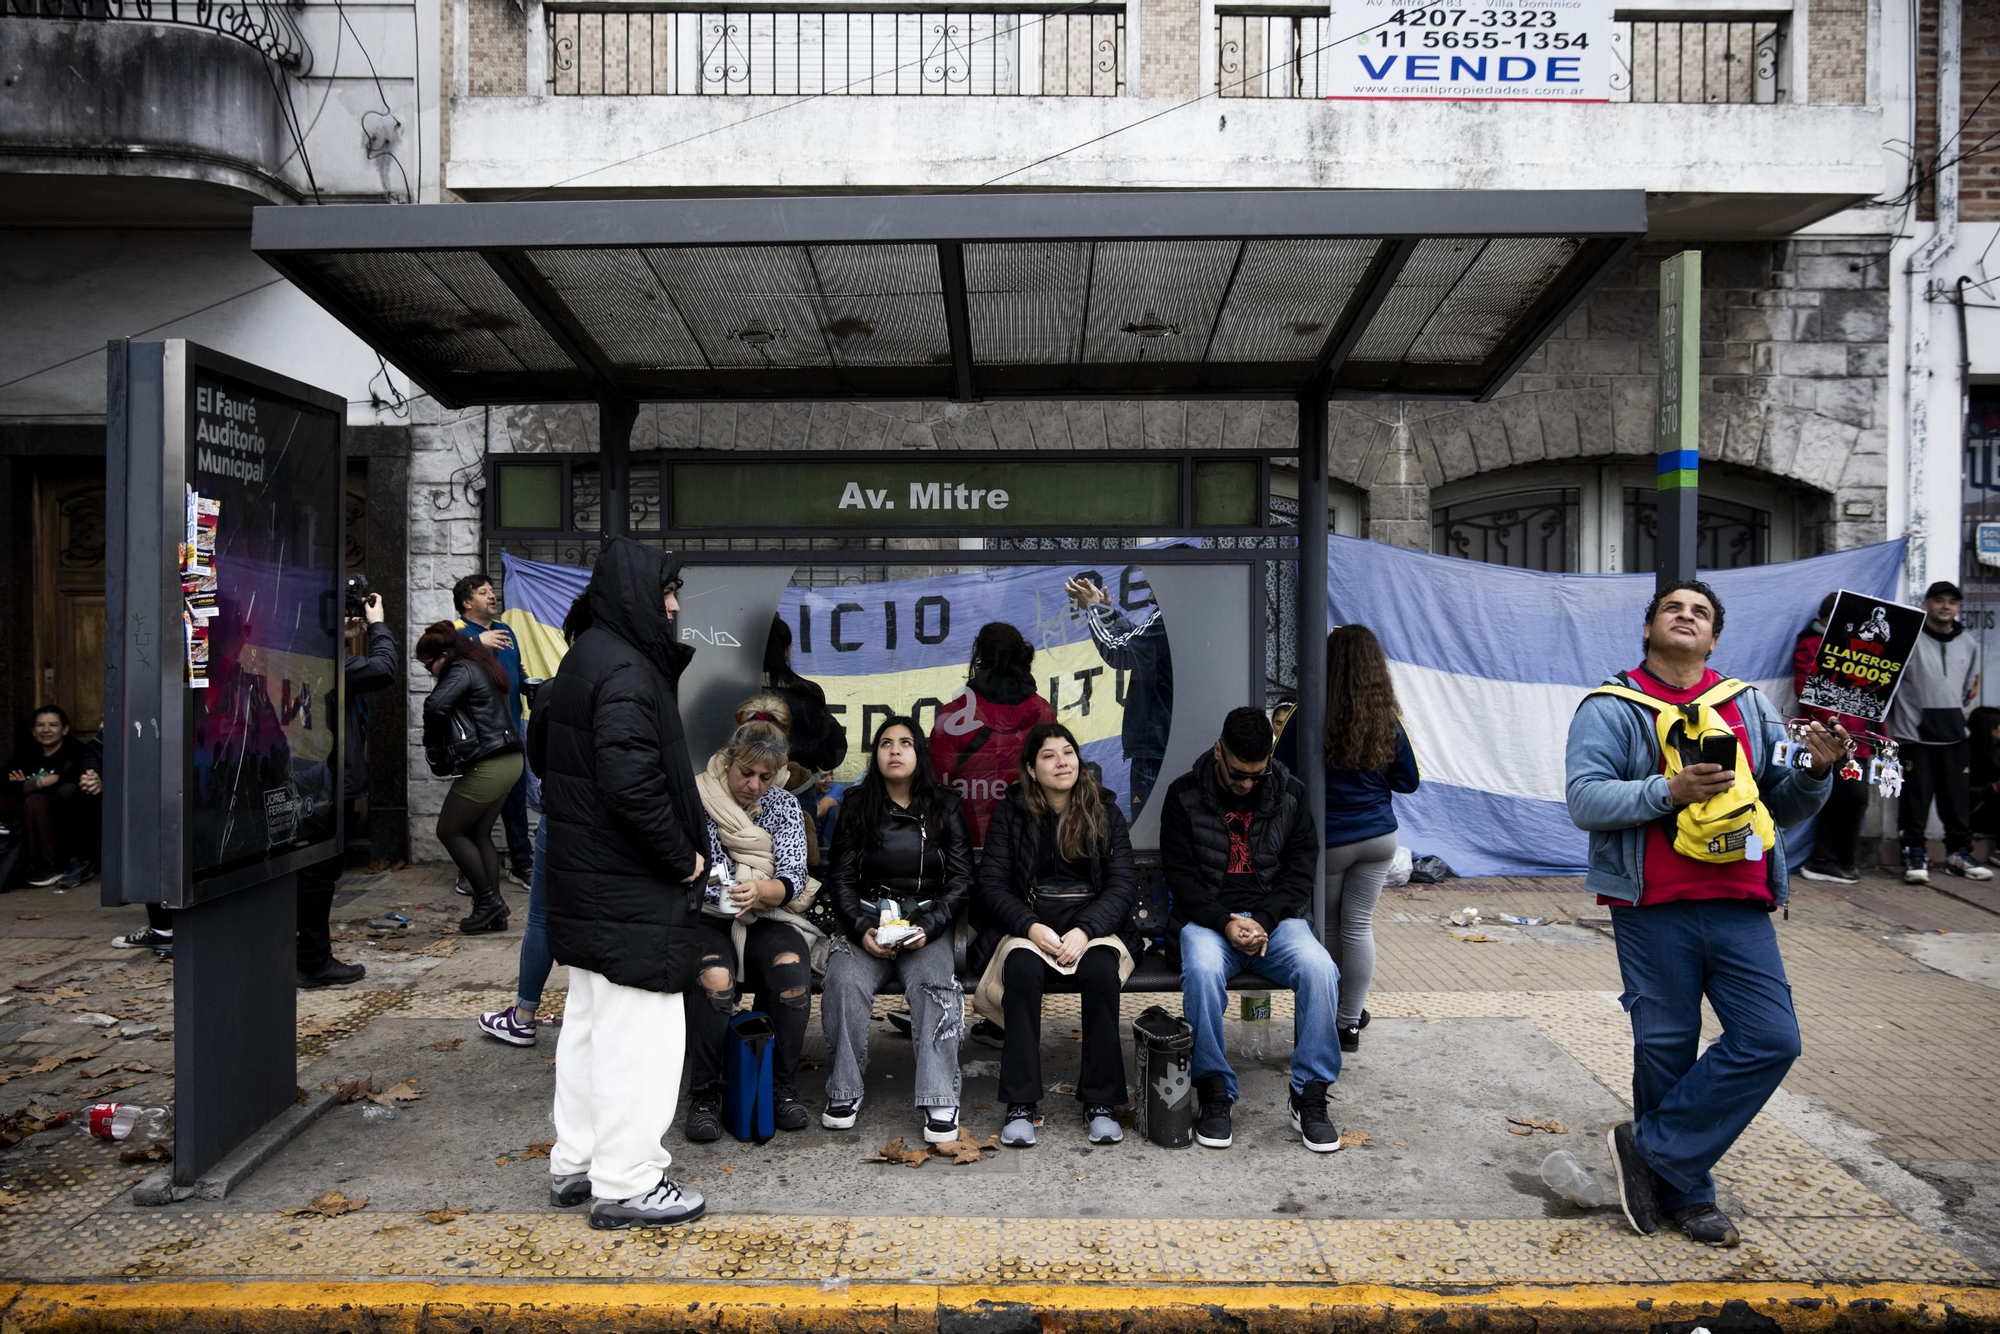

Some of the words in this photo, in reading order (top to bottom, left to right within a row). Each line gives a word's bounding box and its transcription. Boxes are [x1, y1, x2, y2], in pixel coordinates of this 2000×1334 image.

[1389, 9, 1557, 28] 4207-3323
[1375, 31, 1406, 48] 11
[1423, 31, 1589, 50] 5655-1354
[1357, 55, 1581, 82] VENDE
[1353, 85, 1585, 96] www.cariatipropiedades.com.ar
[1665, 271, 1676, 304] 17
[1664, 304, 1676, 337] 22
[1664, 339, 1675, 371] 98
[1662, 370, 1678, 403] 148
[197, 386, 212, 413] El
[216, 391, 256, 424] Fauré
[1661, 403, 1678, 436] 570
[196, 417, 265, 455] Auditorio
[198, 446, 264, 486] Municipal
[838, 482, 894, 509] Av.
[909, 482, 1010, 510] Mitre
[1822, 656, 1892, 686] 3.000$
[1824, 644, 1901, 672] LLAVEROS
